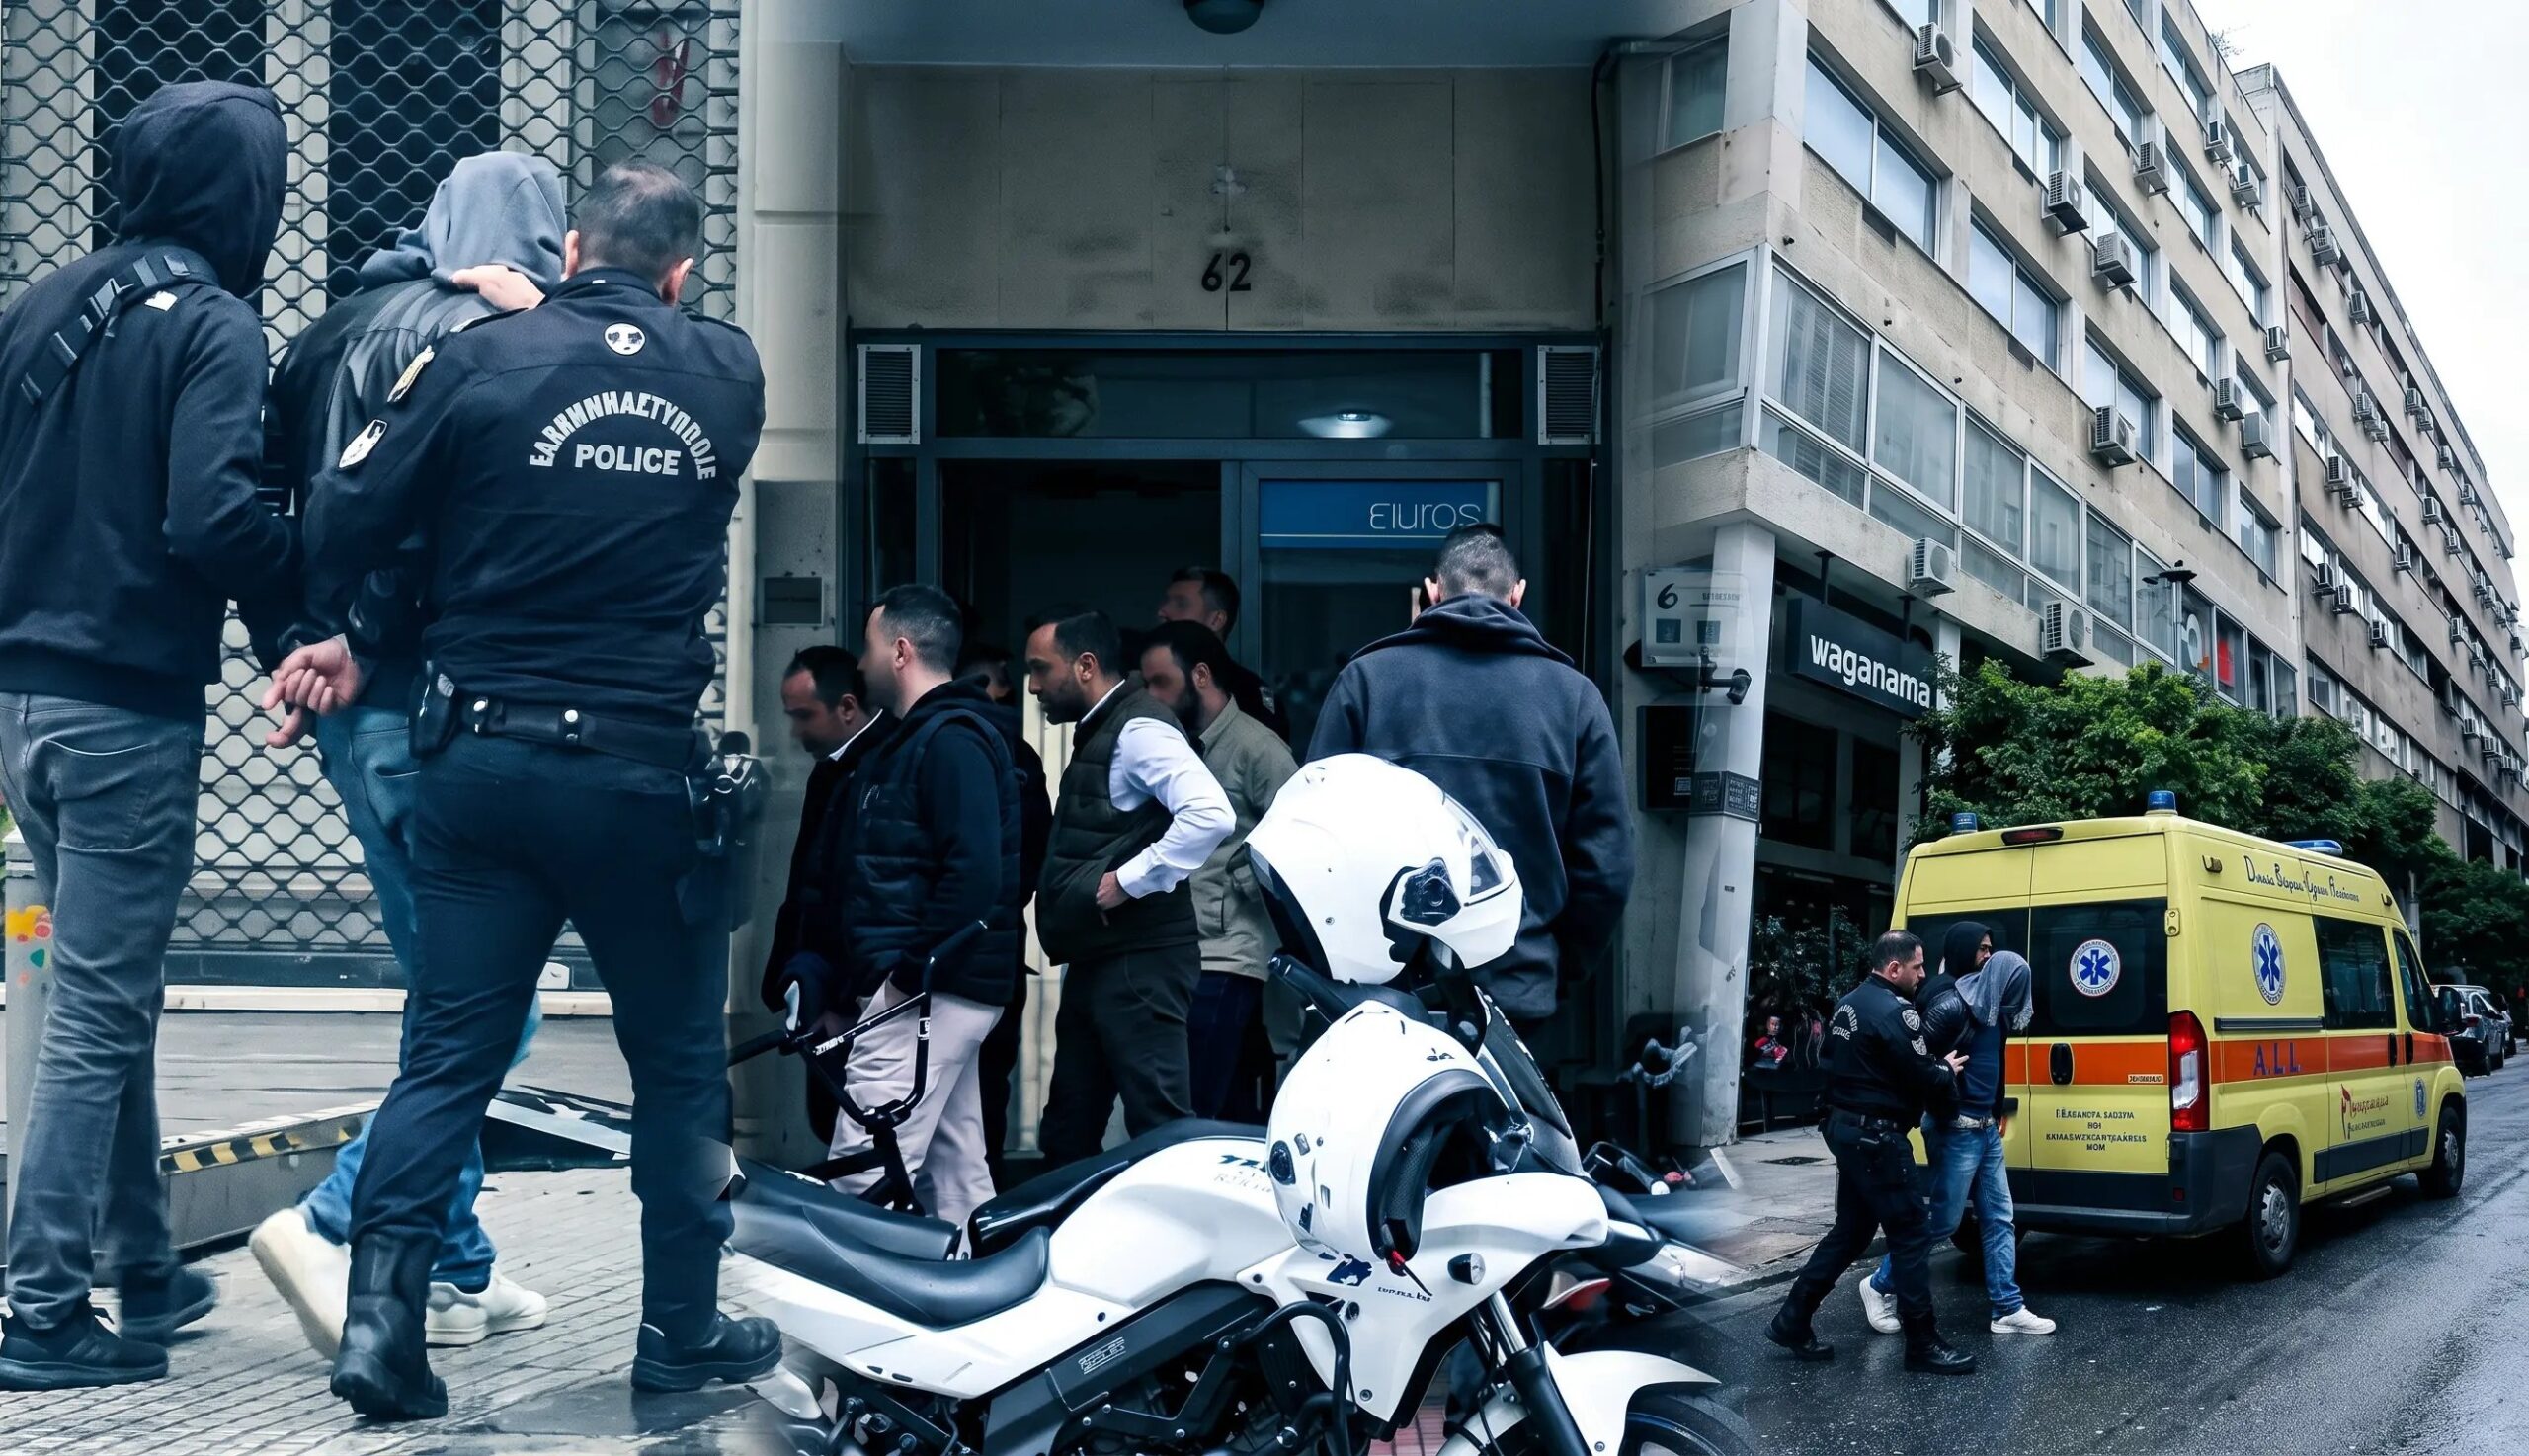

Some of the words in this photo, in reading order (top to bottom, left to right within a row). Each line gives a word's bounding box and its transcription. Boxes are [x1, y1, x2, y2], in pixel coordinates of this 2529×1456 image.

[1201, 252, 1252, 292] 62
[574, 444, 682, 475] POLICE
[1657, 583, 1678, 609] 6
[1810, 634, 1930, 709] waganama
